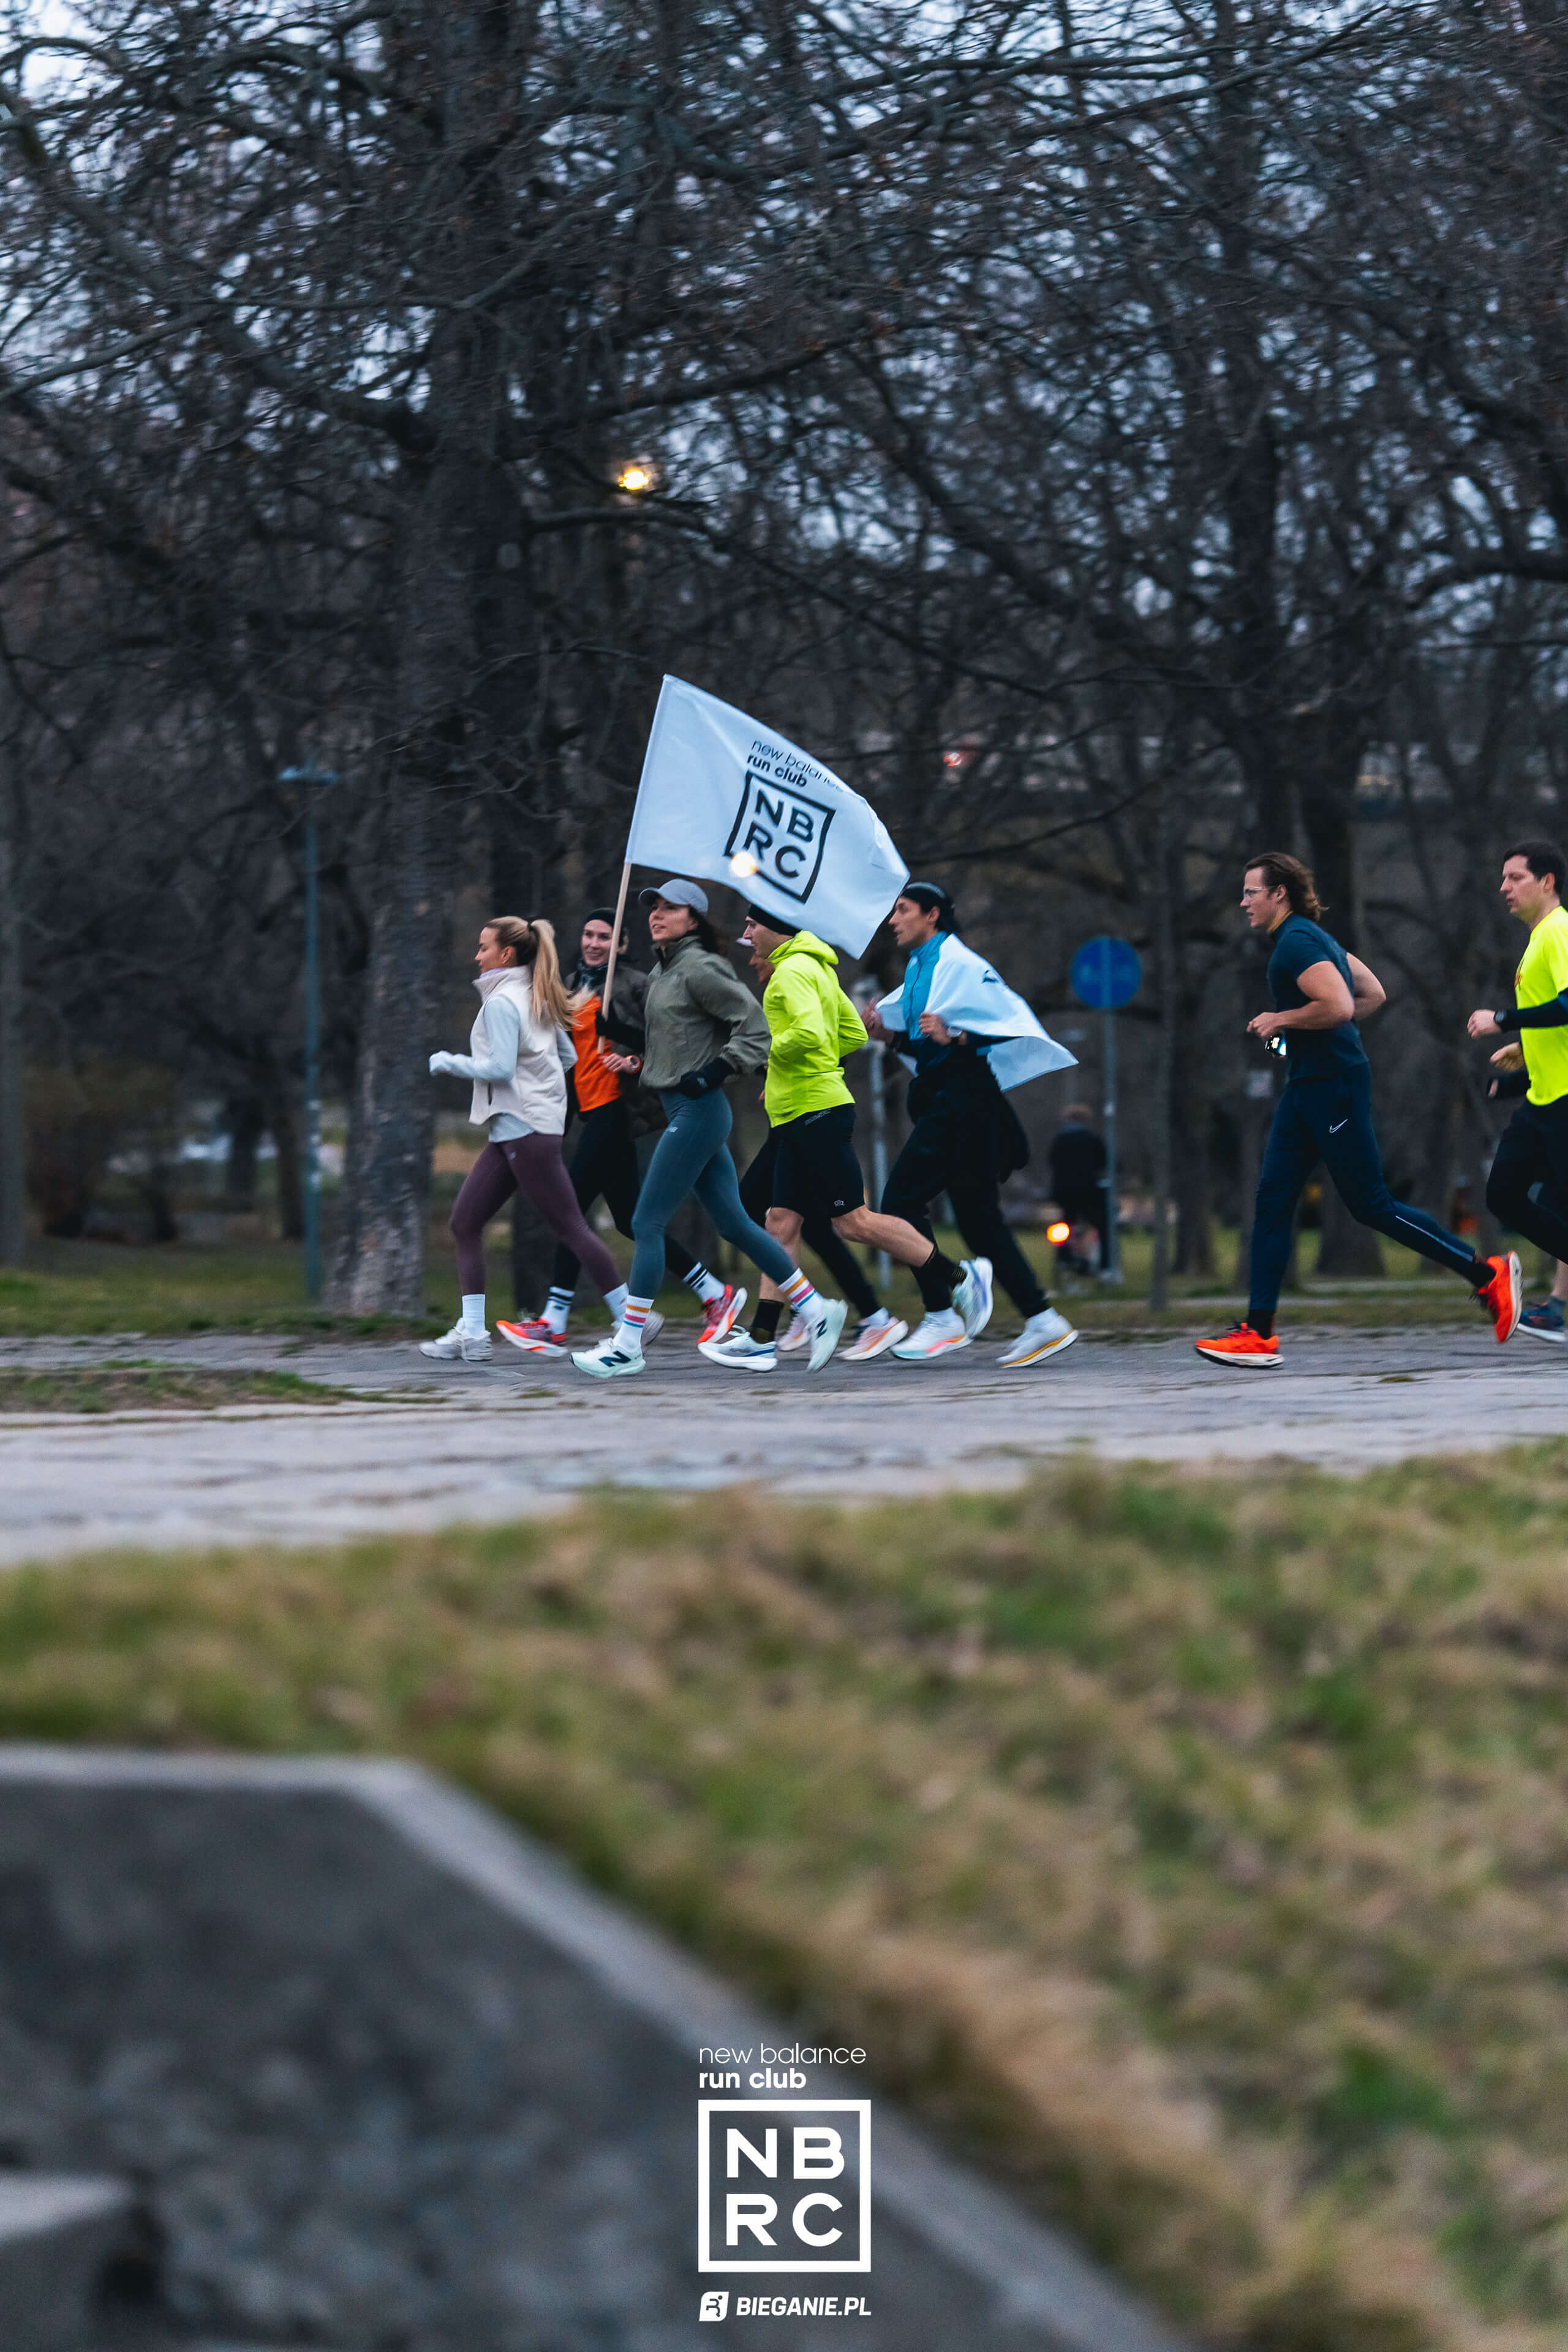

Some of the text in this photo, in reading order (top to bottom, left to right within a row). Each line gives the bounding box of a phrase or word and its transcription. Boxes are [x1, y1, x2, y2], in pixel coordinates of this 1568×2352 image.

[747, 754, 807, 787] run club
[751, 740, 783, 760] new
[755, 789, 814, 842] NB
[743, 822, 806, 878] RC
